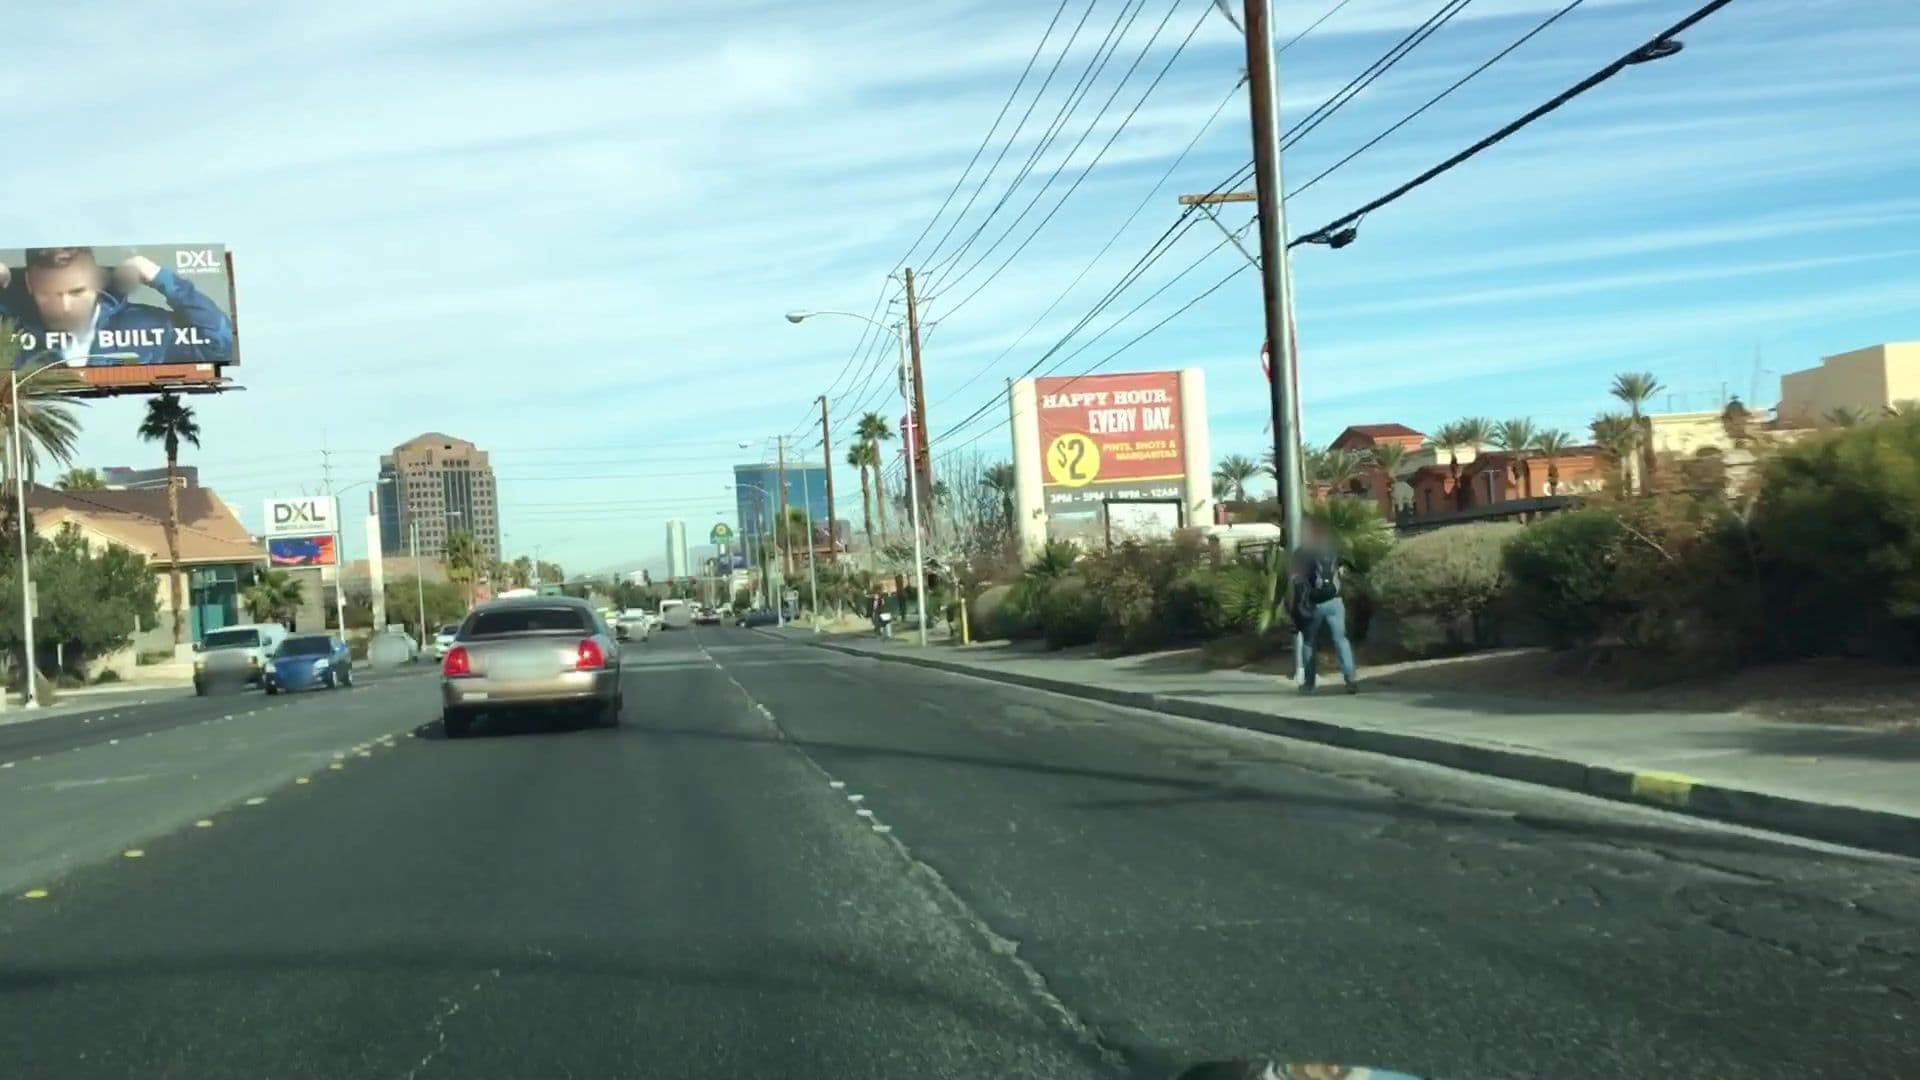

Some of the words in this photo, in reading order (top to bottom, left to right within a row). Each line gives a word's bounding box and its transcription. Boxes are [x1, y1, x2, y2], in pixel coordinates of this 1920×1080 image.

[176, 250, 221, 267] DXL
[98, 327, 165, 347] BUILT
[175, 327, 211, 345] XL.
[1042, 392, 1109, 408] HAPPY
[1113, 389, 1173, 405] HOUR.
[1088, 408, 1136, 434] EVERY
[1142, 406, 1175, 431] DAY.
[1135, 440, 1167, 450] SHOTS
[1057, 439, 1086, 480] $2
[274, 501, 326, 524] DXL
